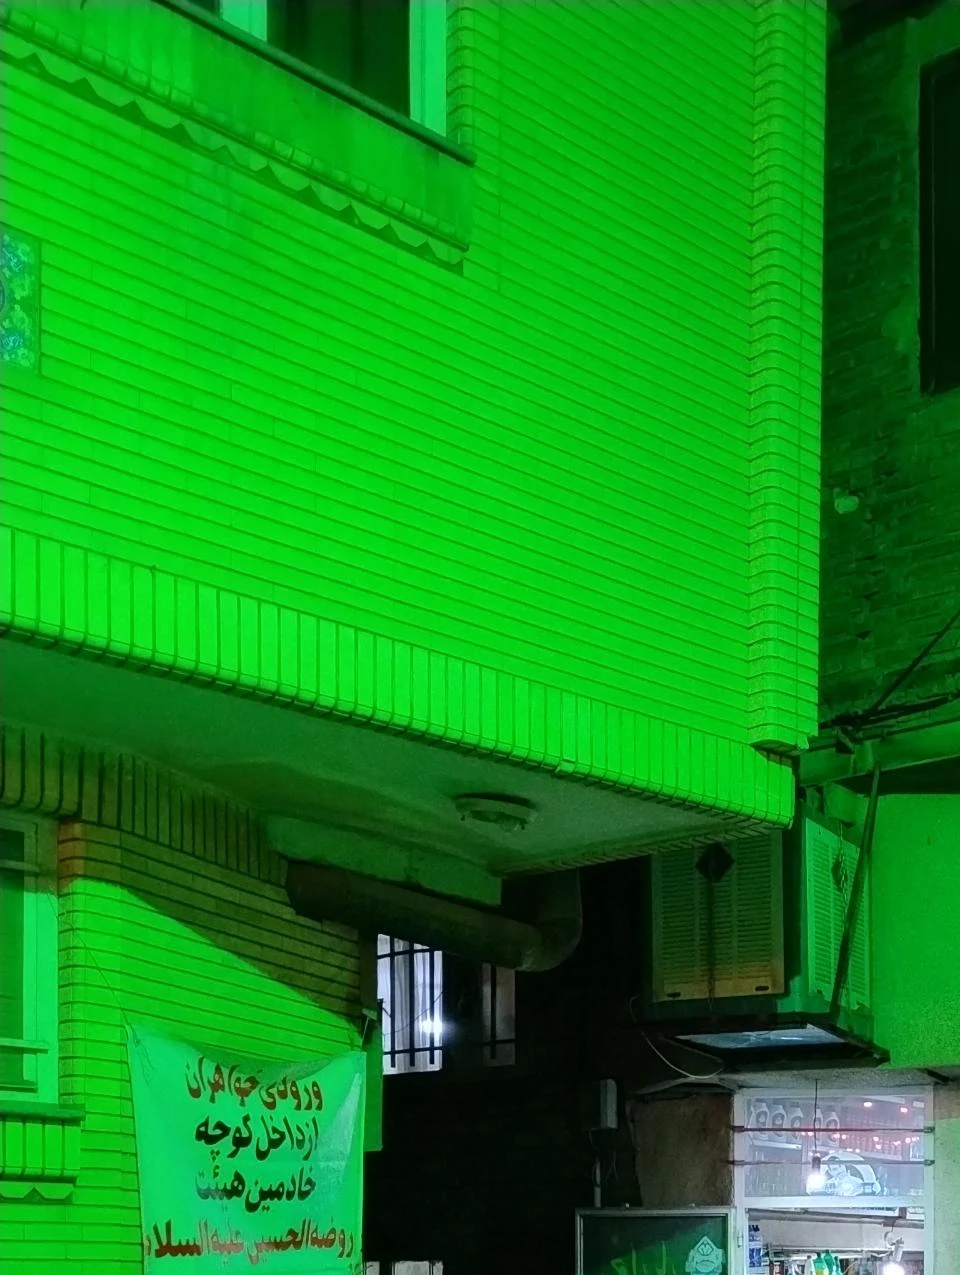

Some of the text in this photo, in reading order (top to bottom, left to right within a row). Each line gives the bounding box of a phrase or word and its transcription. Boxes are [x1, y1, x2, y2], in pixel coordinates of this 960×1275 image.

[259, 1074, 323, 1112] ورودی
[195, 1113, 253, 1161] کوچه
[245, 1165, 316, 1213] خادمین
